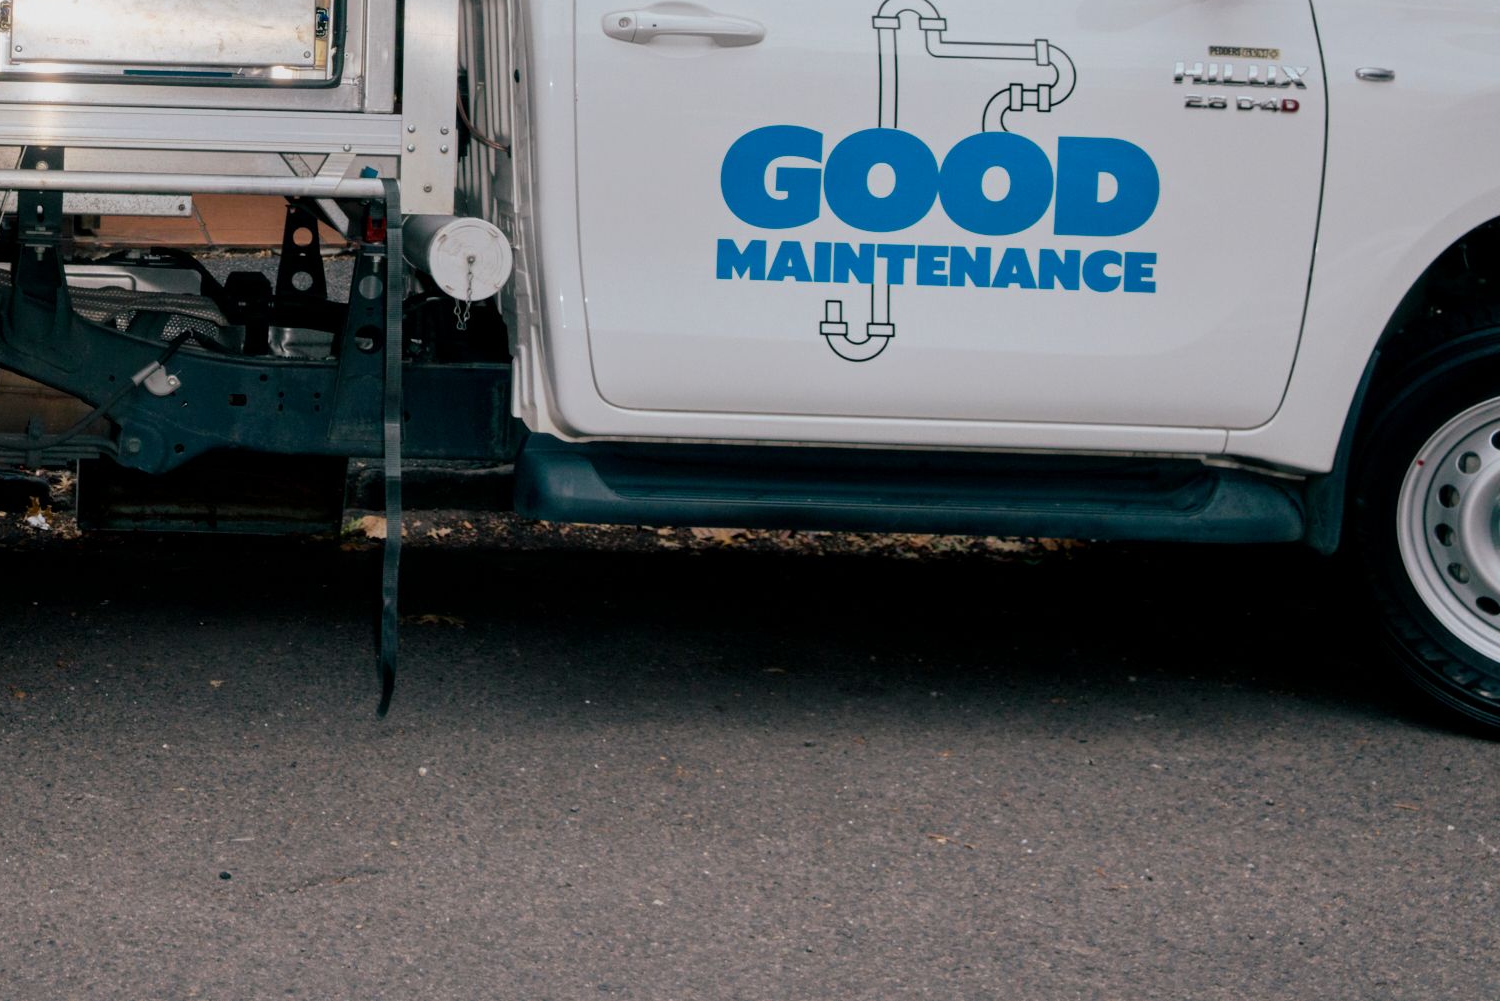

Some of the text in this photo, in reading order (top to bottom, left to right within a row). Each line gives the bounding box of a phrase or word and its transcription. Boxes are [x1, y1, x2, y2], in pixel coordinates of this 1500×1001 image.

[1173, 61, 1309, 90] HILUX
[1184, 93, 1228, 110] 2.8
[720, 124, 1160, 237] GOOD
[716, 238, 1157, 294] MAINTENANCE
